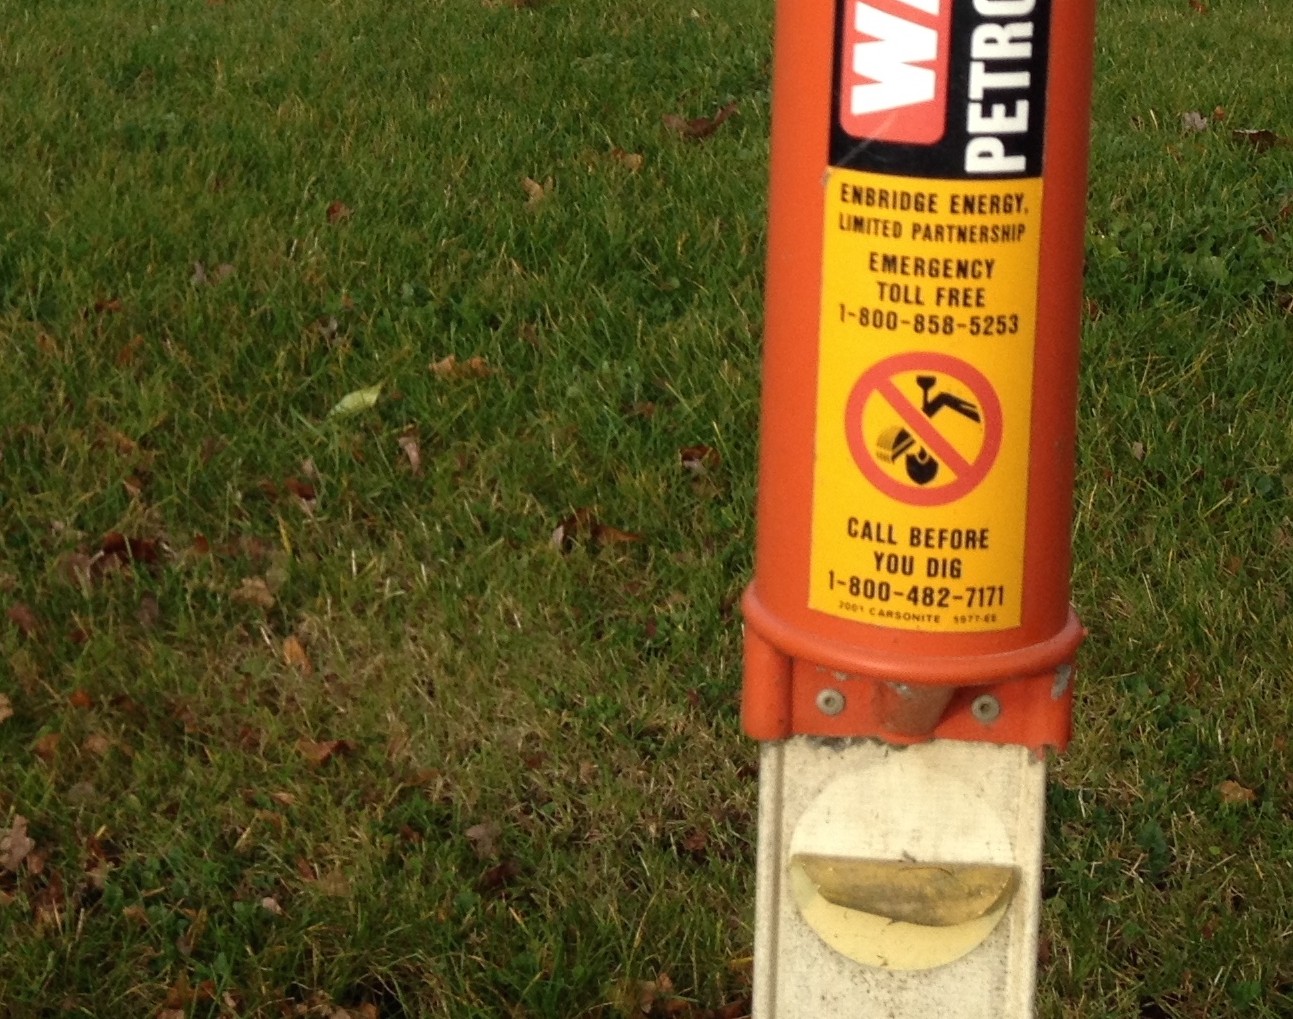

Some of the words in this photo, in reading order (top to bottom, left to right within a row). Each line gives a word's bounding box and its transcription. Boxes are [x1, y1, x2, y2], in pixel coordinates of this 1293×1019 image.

[841, 183, 938, 213] ENBRIDGE
[840, 212, 902, 238] LIMITED
[912, 222, 1025, 243] PARTNERSHIP
[869, 252, 994, 279] EMERGENCY
[877, 282, 924, 306] TOLL
[936, 287, 986, 307] FREE
[840, 304, 1019, 335] 1-800-858-5253
[848, 517, 897, 544] CALL
[909, 527, 989, 549] BEFORE
[874, 551, 914, 576] YOU
[927, 558, 962, 578] DIG
[829, 570, 1004, 607] 1-800-482-7171
[869, 607, 940, 623] CARSONITE
